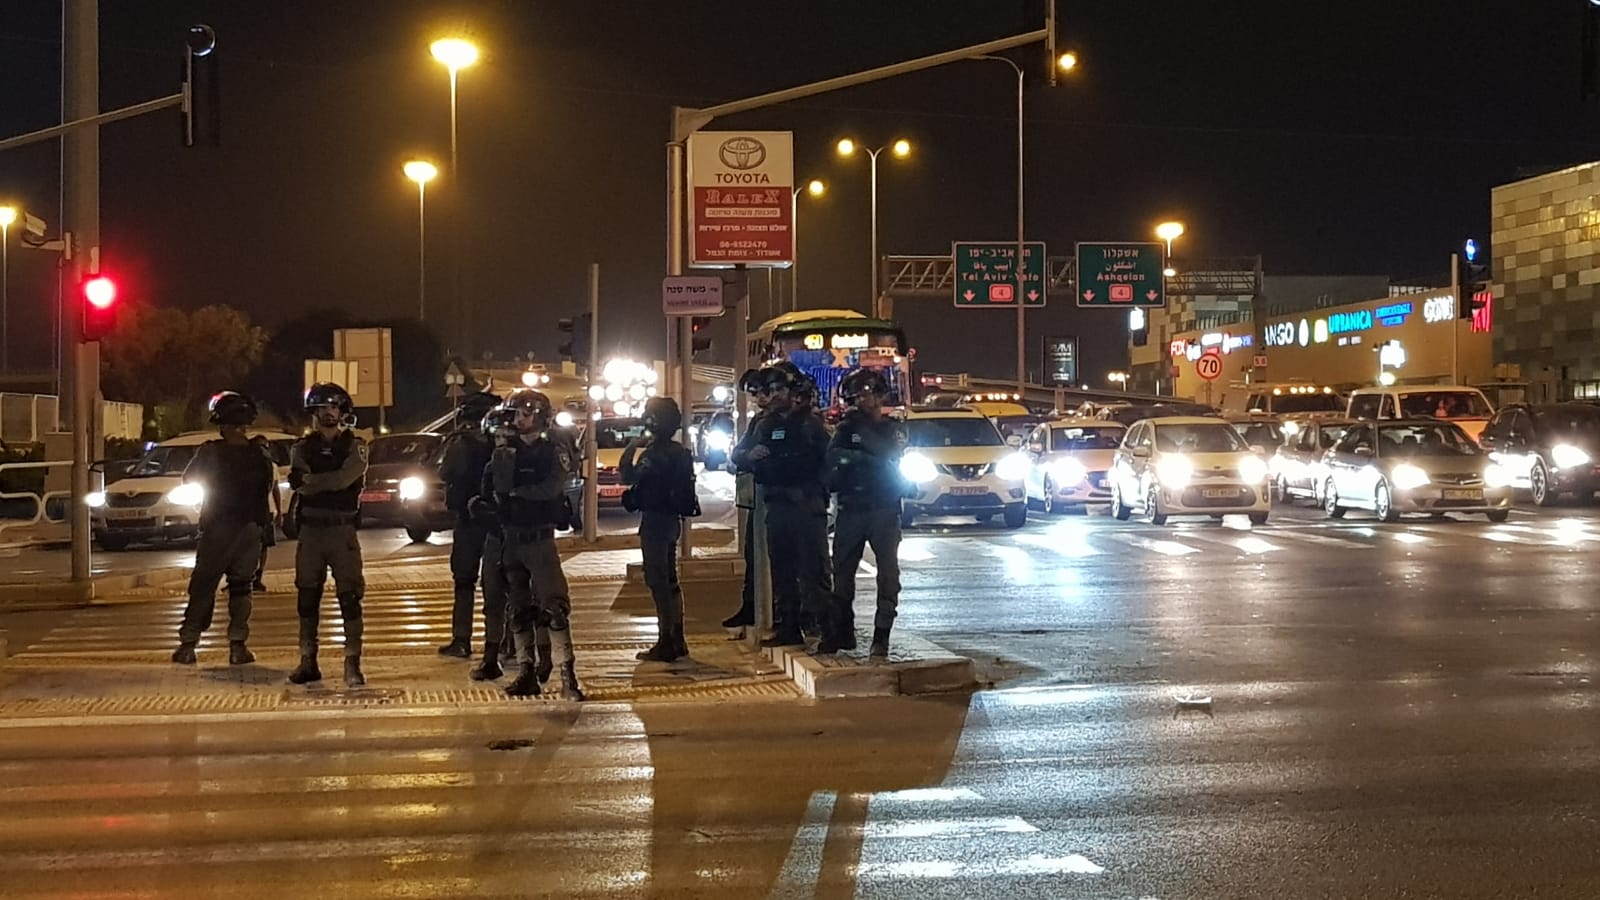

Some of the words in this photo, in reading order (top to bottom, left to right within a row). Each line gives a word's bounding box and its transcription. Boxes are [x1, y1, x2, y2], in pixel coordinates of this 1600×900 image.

[715, 173, 770, 184] TOYOTA
[705, 189, 780, 205] RALEX
[756, 249, 781, 257] אשדוד
[1103, 248, 1140, 259] אשקלון
[962, 272, 979, 281] Tel
[1096, 272, 1145, 283] Ashqelon
[1328, 310, 1373, 334] URBANICA
[1170, 339, 1186, 357] FOX
[1202, 360, 1218, 374] 70
